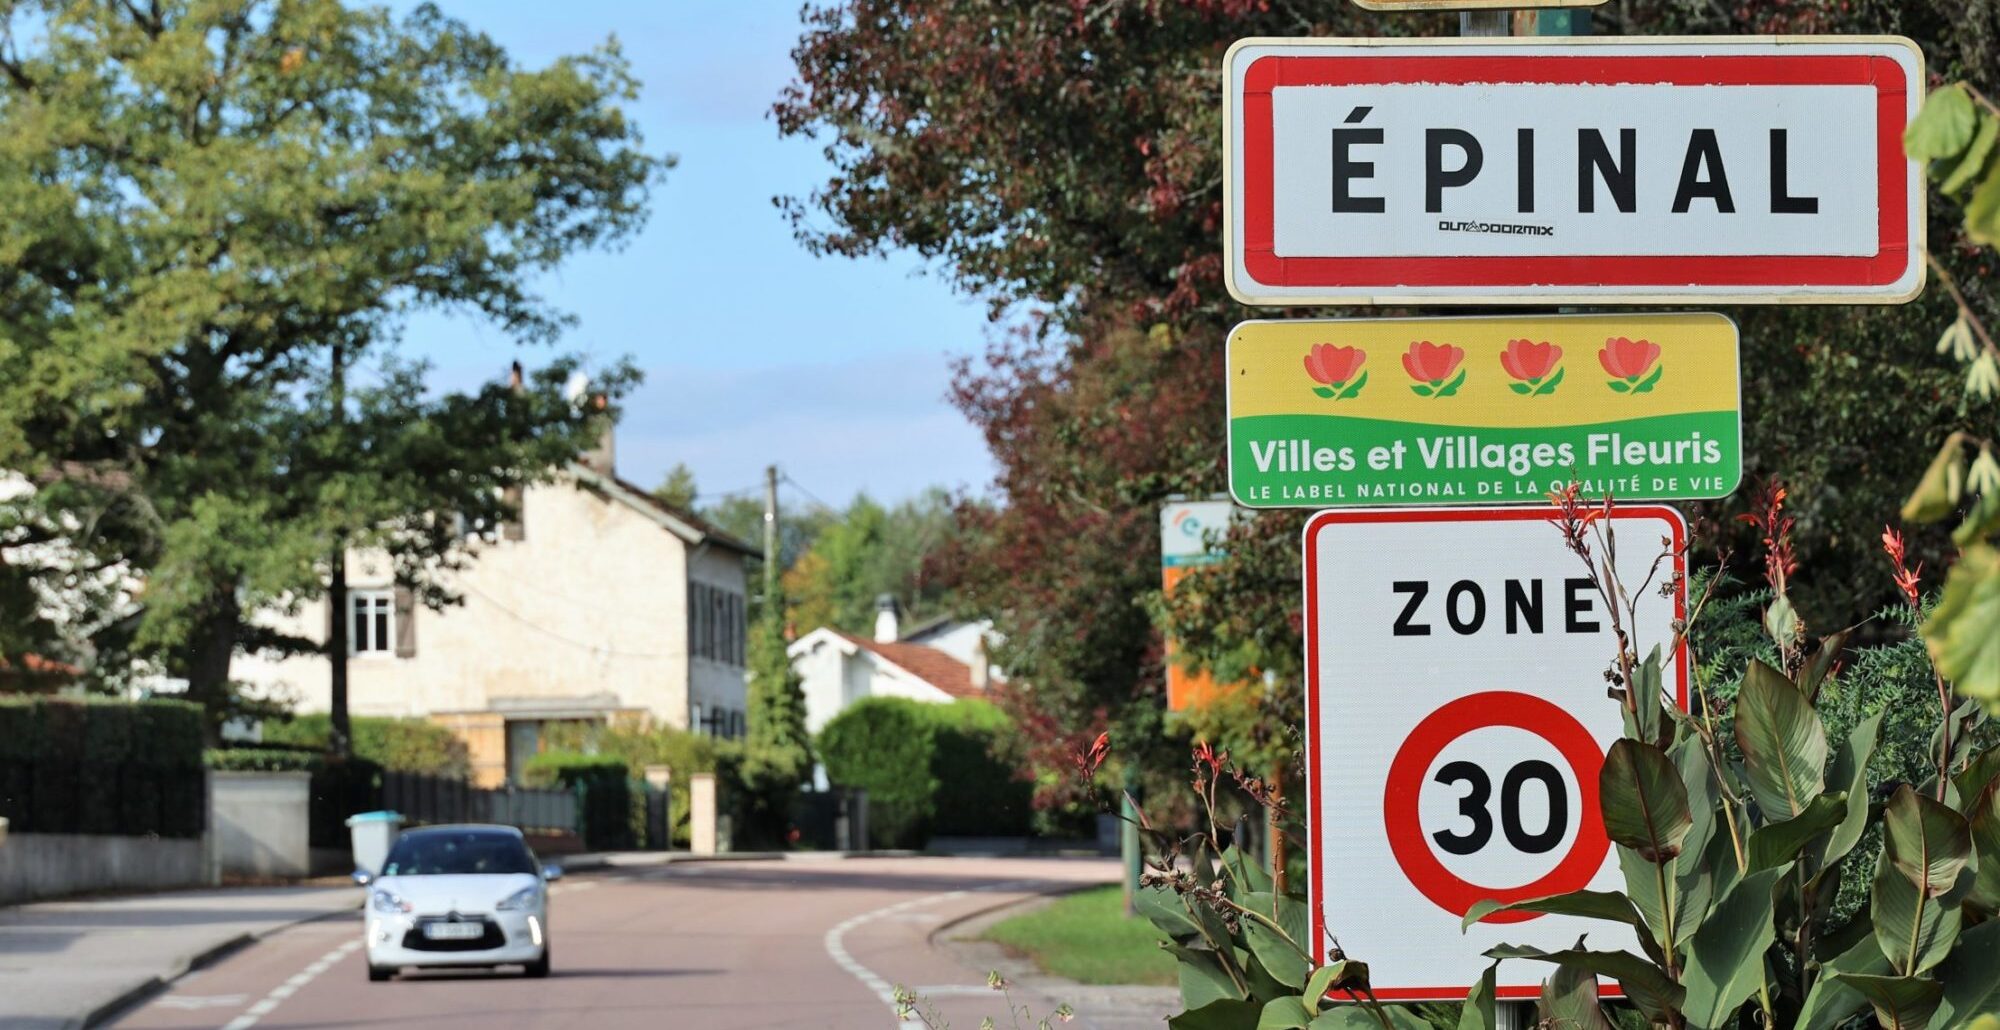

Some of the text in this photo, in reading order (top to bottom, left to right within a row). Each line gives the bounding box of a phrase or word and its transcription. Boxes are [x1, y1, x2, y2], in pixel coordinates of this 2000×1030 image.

[1331, 106, 1819, 214] ÉPINAL
[1249, 431, 1722, 476] Villes et Villages Fleuris
[1250, 486, 1271, 499] LE
[1282, 484, 1346, 499] LABEL
[1357, 481, 1466, 498] NATIONAL
[1478, 481, 1503, 495] DE
[1515, 480, 1539, 494] LA
[1652, 477, 1678, 492] DE
[1689, 477, 1723, 491] VIE
[1392, 578, 1601, 637] ZONE
[1432, 759, 1568, 856] 30
